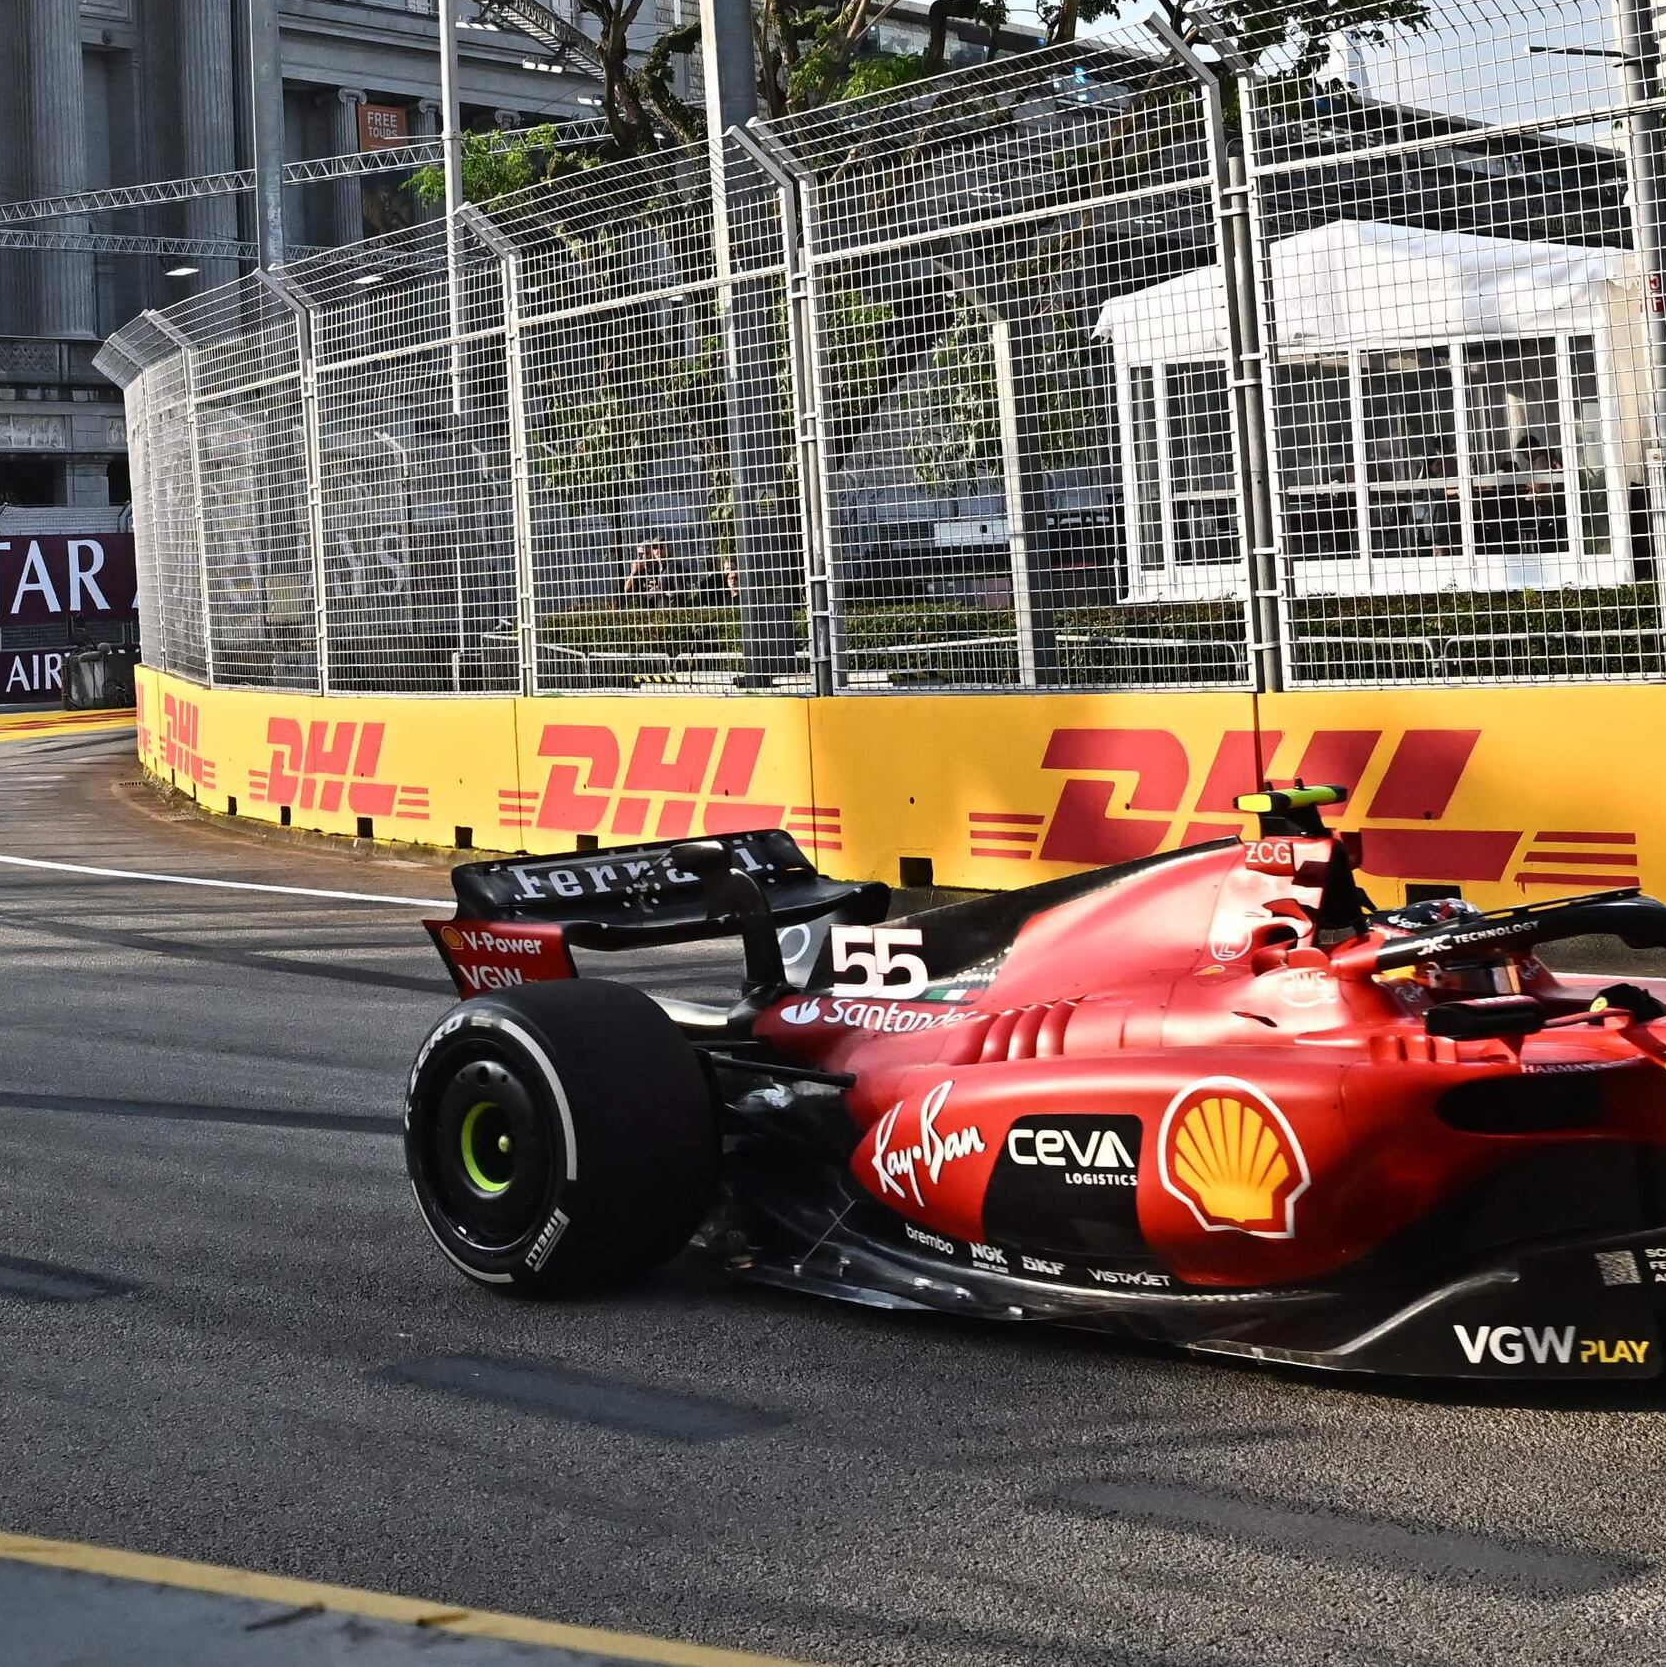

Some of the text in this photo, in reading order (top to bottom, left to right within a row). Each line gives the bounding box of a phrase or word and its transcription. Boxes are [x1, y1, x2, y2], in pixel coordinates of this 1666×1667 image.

[5, 653, 70, 691] AIR
[165, 693, 203, 784] DHL
[267, 716, 397, 816] DHL
[536, 724, 785, 837] DHL
[1038, 728, 1524, 882] DHL
[1245, 840, 1292, 864] ZCG
[462, 931, 542, 956] V-Power
[1453, 920, 1540, 944] TECHNOLOGY
[460, 964, 523, 991] VGW
[830, 924, 929, 1000] 55
[823, 998, 985, 1033] Santander
[1064, 1171, 1139, 1186] LOGISTICS
[904, 1222, 955, 1255] brembo
[969, 1241, 1009, 1265] NGK
[1021, 1255, 1066, 1276] SKF
[1453, 1324, 1650, 1365] VGW PLAY
